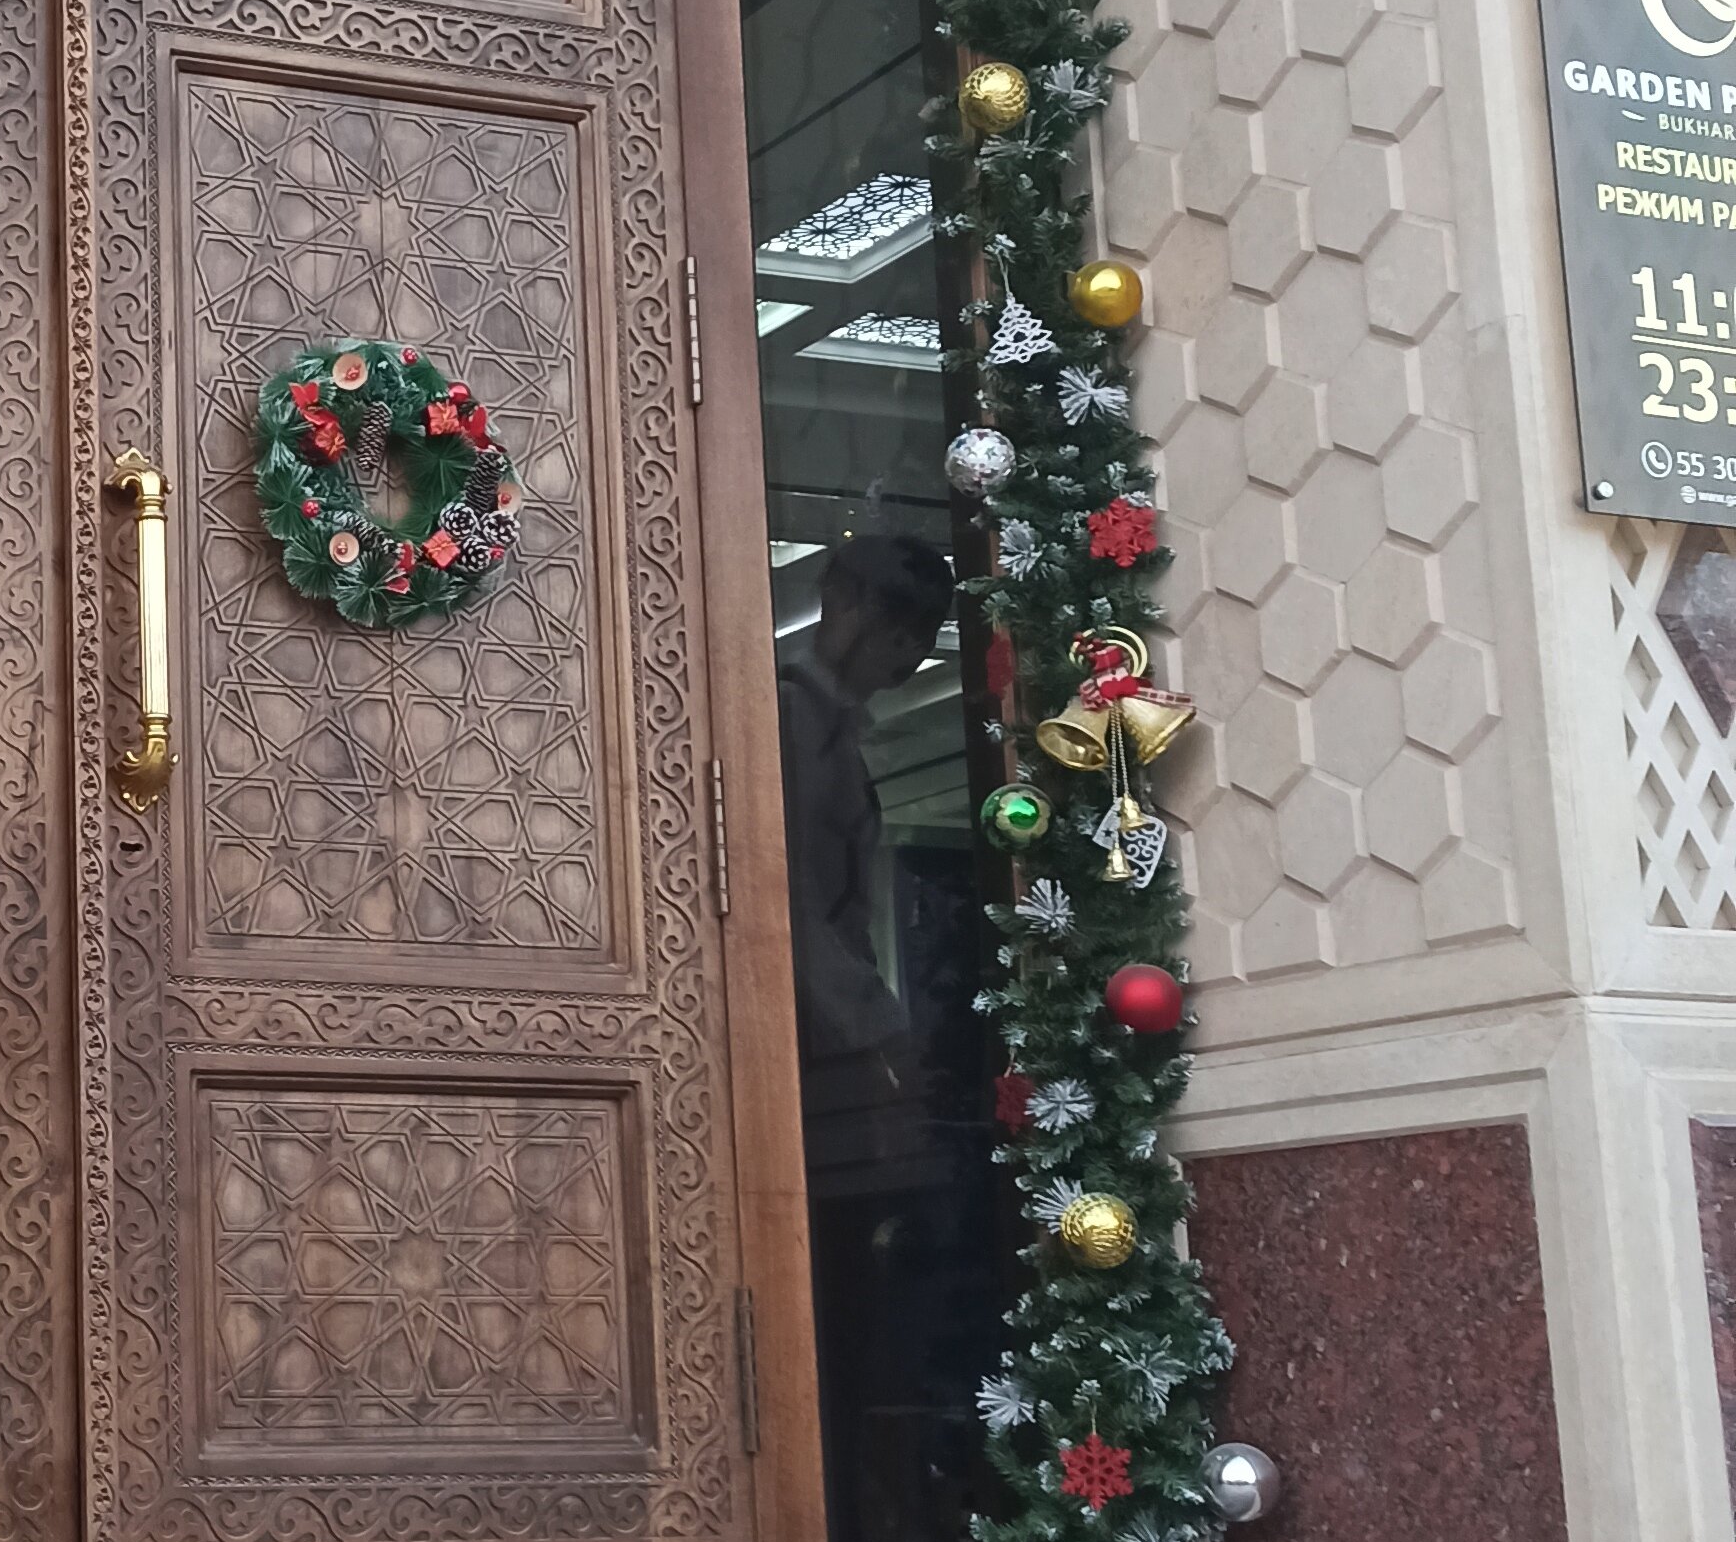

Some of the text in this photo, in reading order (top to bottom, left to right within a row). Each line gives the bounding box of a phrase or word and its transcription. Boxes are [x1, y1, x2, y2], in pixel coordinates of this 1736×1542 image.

[1563, 60, 1712, 111] GARDEN
[1597, 183, 1705, 226] РЕЖИМ
[1676, 451, 1705, 477] 55
